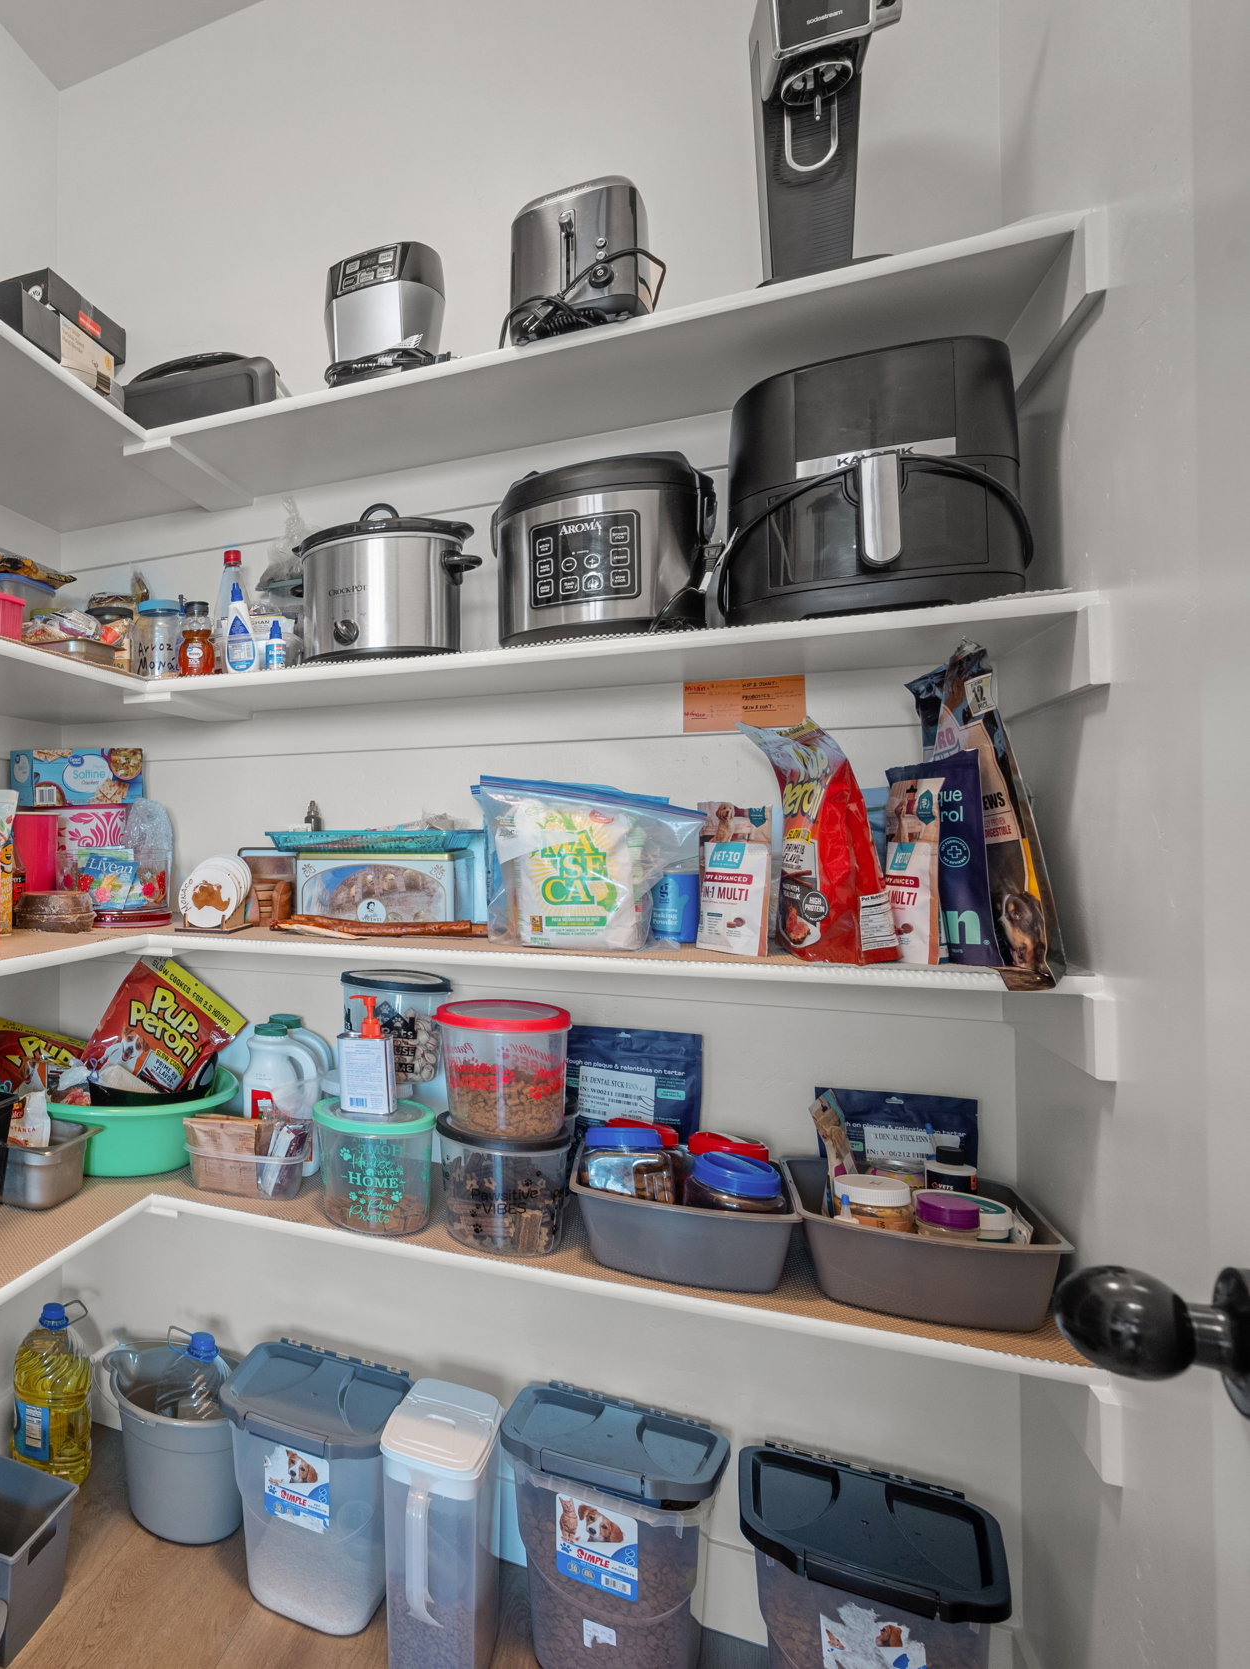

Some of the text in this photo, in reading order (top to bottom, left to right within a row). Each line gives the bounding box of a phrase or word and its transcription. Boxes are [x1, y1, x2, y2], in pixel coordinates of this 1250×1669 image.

[806, 10, 843, 24] sodastream
[559, 519, 602, 536] AROMA
[138, 642, 174, 657] Arroz
[972, 684, 986, 703] 12
[73, 769, 106, 780] Saltine
[938, 788, 962, 805] que
[983, 792, 1006, 810] EWS
[545, 832, 594, 854] MA
[562, 855, 606, 879] SE
[714, 875, 748, 883] ADVANCED
[181, 878, 194, 912] MONACO
[544, 878, 590, 903] CA
[718, 887, 749, 902] MULTI
[805, 903, 826, 913] PROTEIN
[809, 896, 822, 905] HIGH
[653, 912, 678, 921] Baking
[151, 960, 231, 1026] SLOW COOKED FOR 2.5 HOURS
[129, 1000, 203, 1068] Peroni
[155, 1049, 170, 1062] SLOW
[395, 1046, 416, 1056] USE
[155, 1059, 172, 1074] PRIME
[593, 1061, 613, 1070] plaque
[620, 1065, 652, 1074] relentless
[590, 1076, 610, 1086] DENTAL
[878, 1133, 899, 1141] DENAL
[348, 1171, 400, 1189] HOME
[358, 1188, 386, 1198] without
[471, 1188, 539, 1200] Pawsitive
[367, 1198, 398, 1212] Paw
[482, 1202, 527, 1214] VIBES
[349, 1204, 390, 1224] Prints
[281, 1489, 307, 1507] SIMPLE
[576, 1548, 610, 1569] SIMPLE
